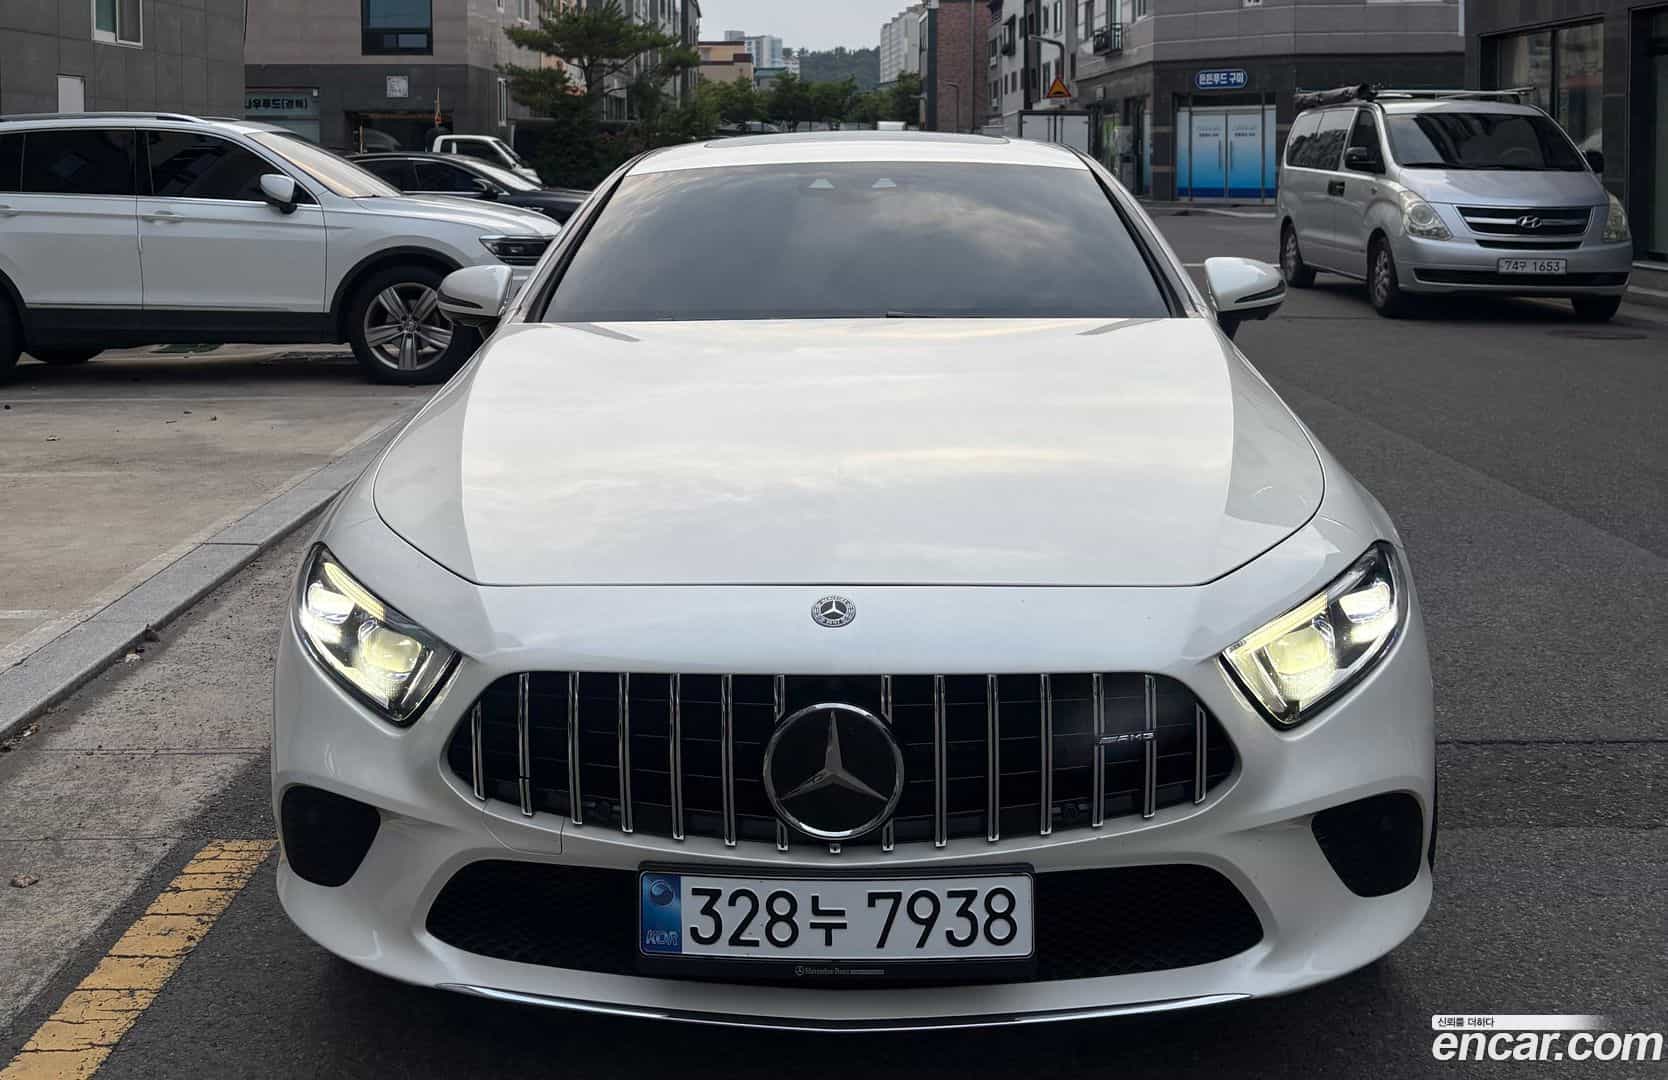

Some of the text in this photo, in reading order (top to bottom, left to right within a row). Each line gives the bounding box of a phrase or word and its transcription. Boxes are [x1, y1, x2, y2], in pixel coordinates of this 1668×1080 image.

[1533, 261, 1560, 272] 1653
[689, 887, 1018, 949] 328누 7938
